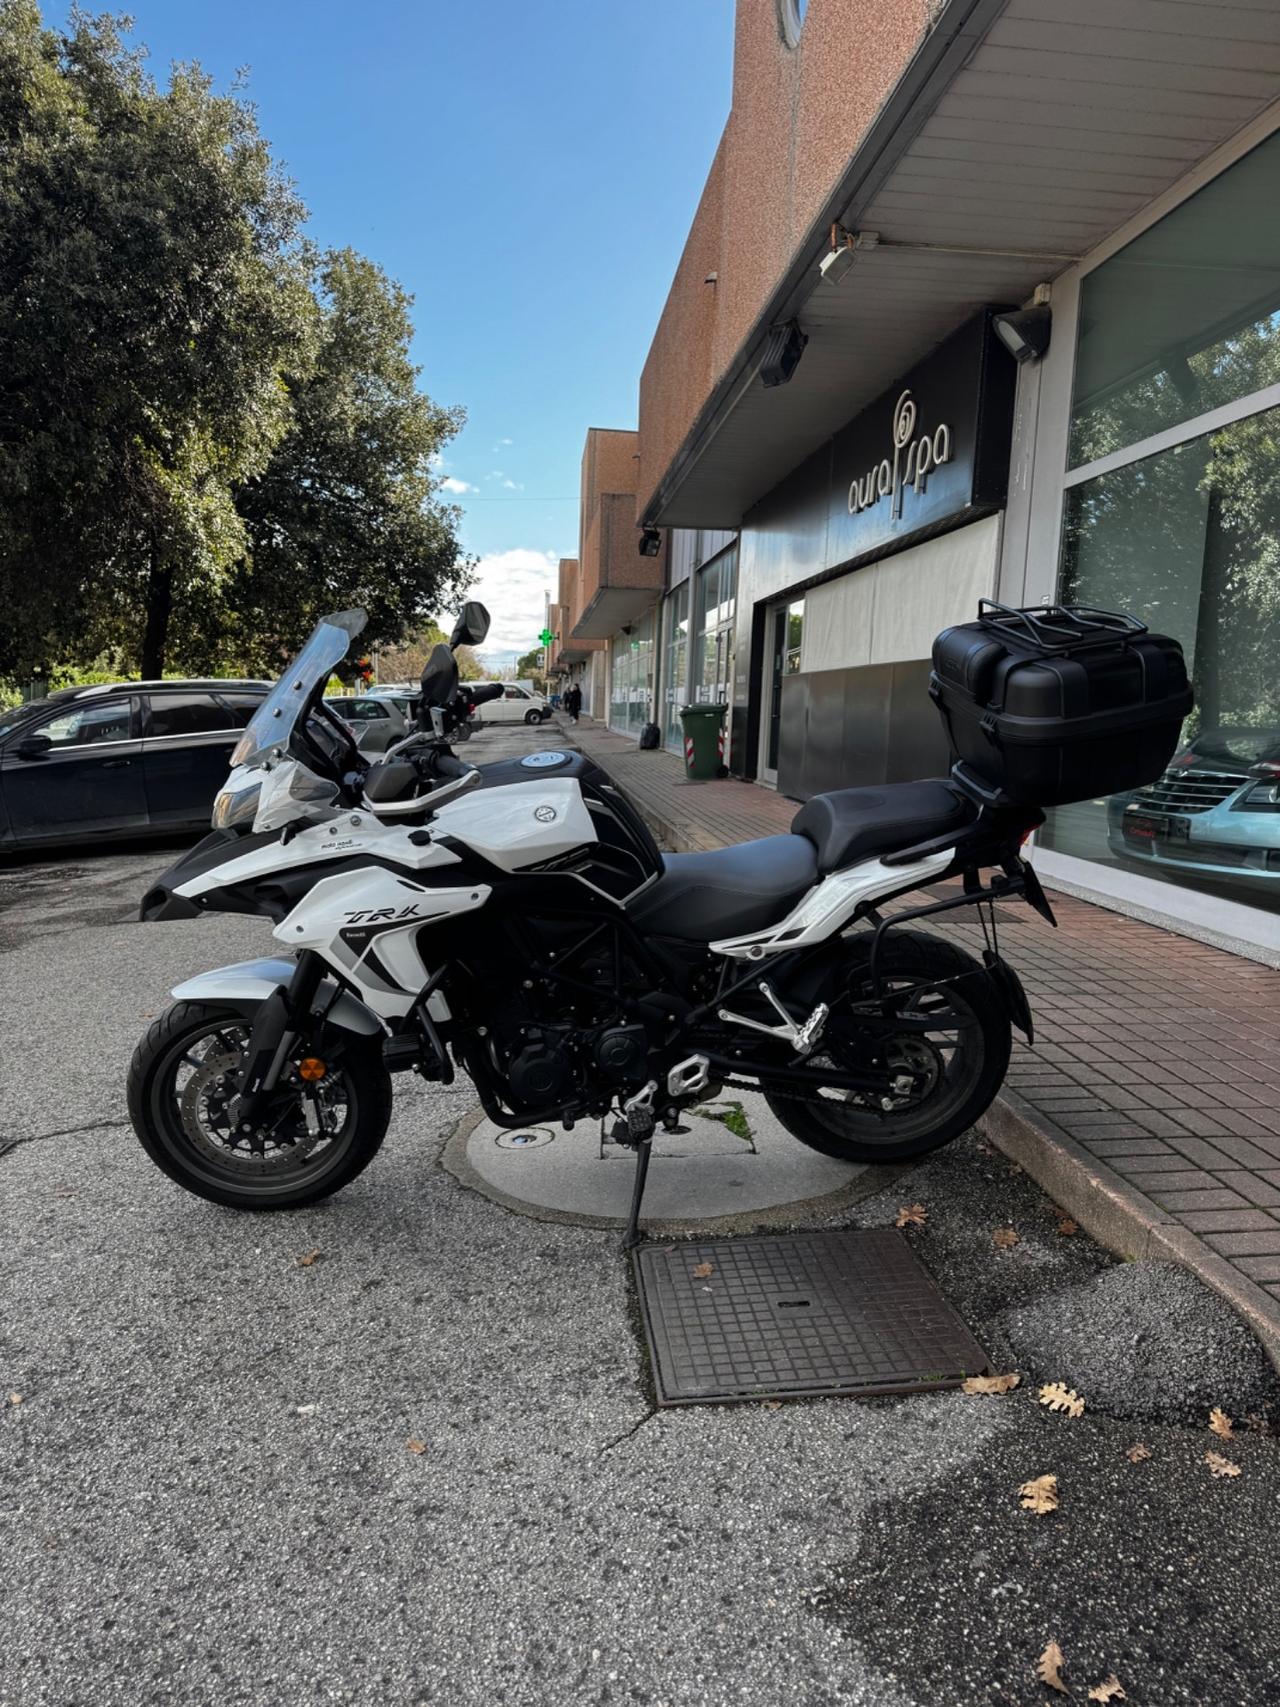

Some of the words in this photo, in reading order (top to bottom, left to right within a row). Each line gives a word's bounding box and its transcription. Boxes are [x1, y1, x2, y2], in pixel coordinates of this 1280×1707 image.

[848, 459, 892, 514] aura
[902, 424, 950, 494] spa
[344, 904, 420, 924] TRK
